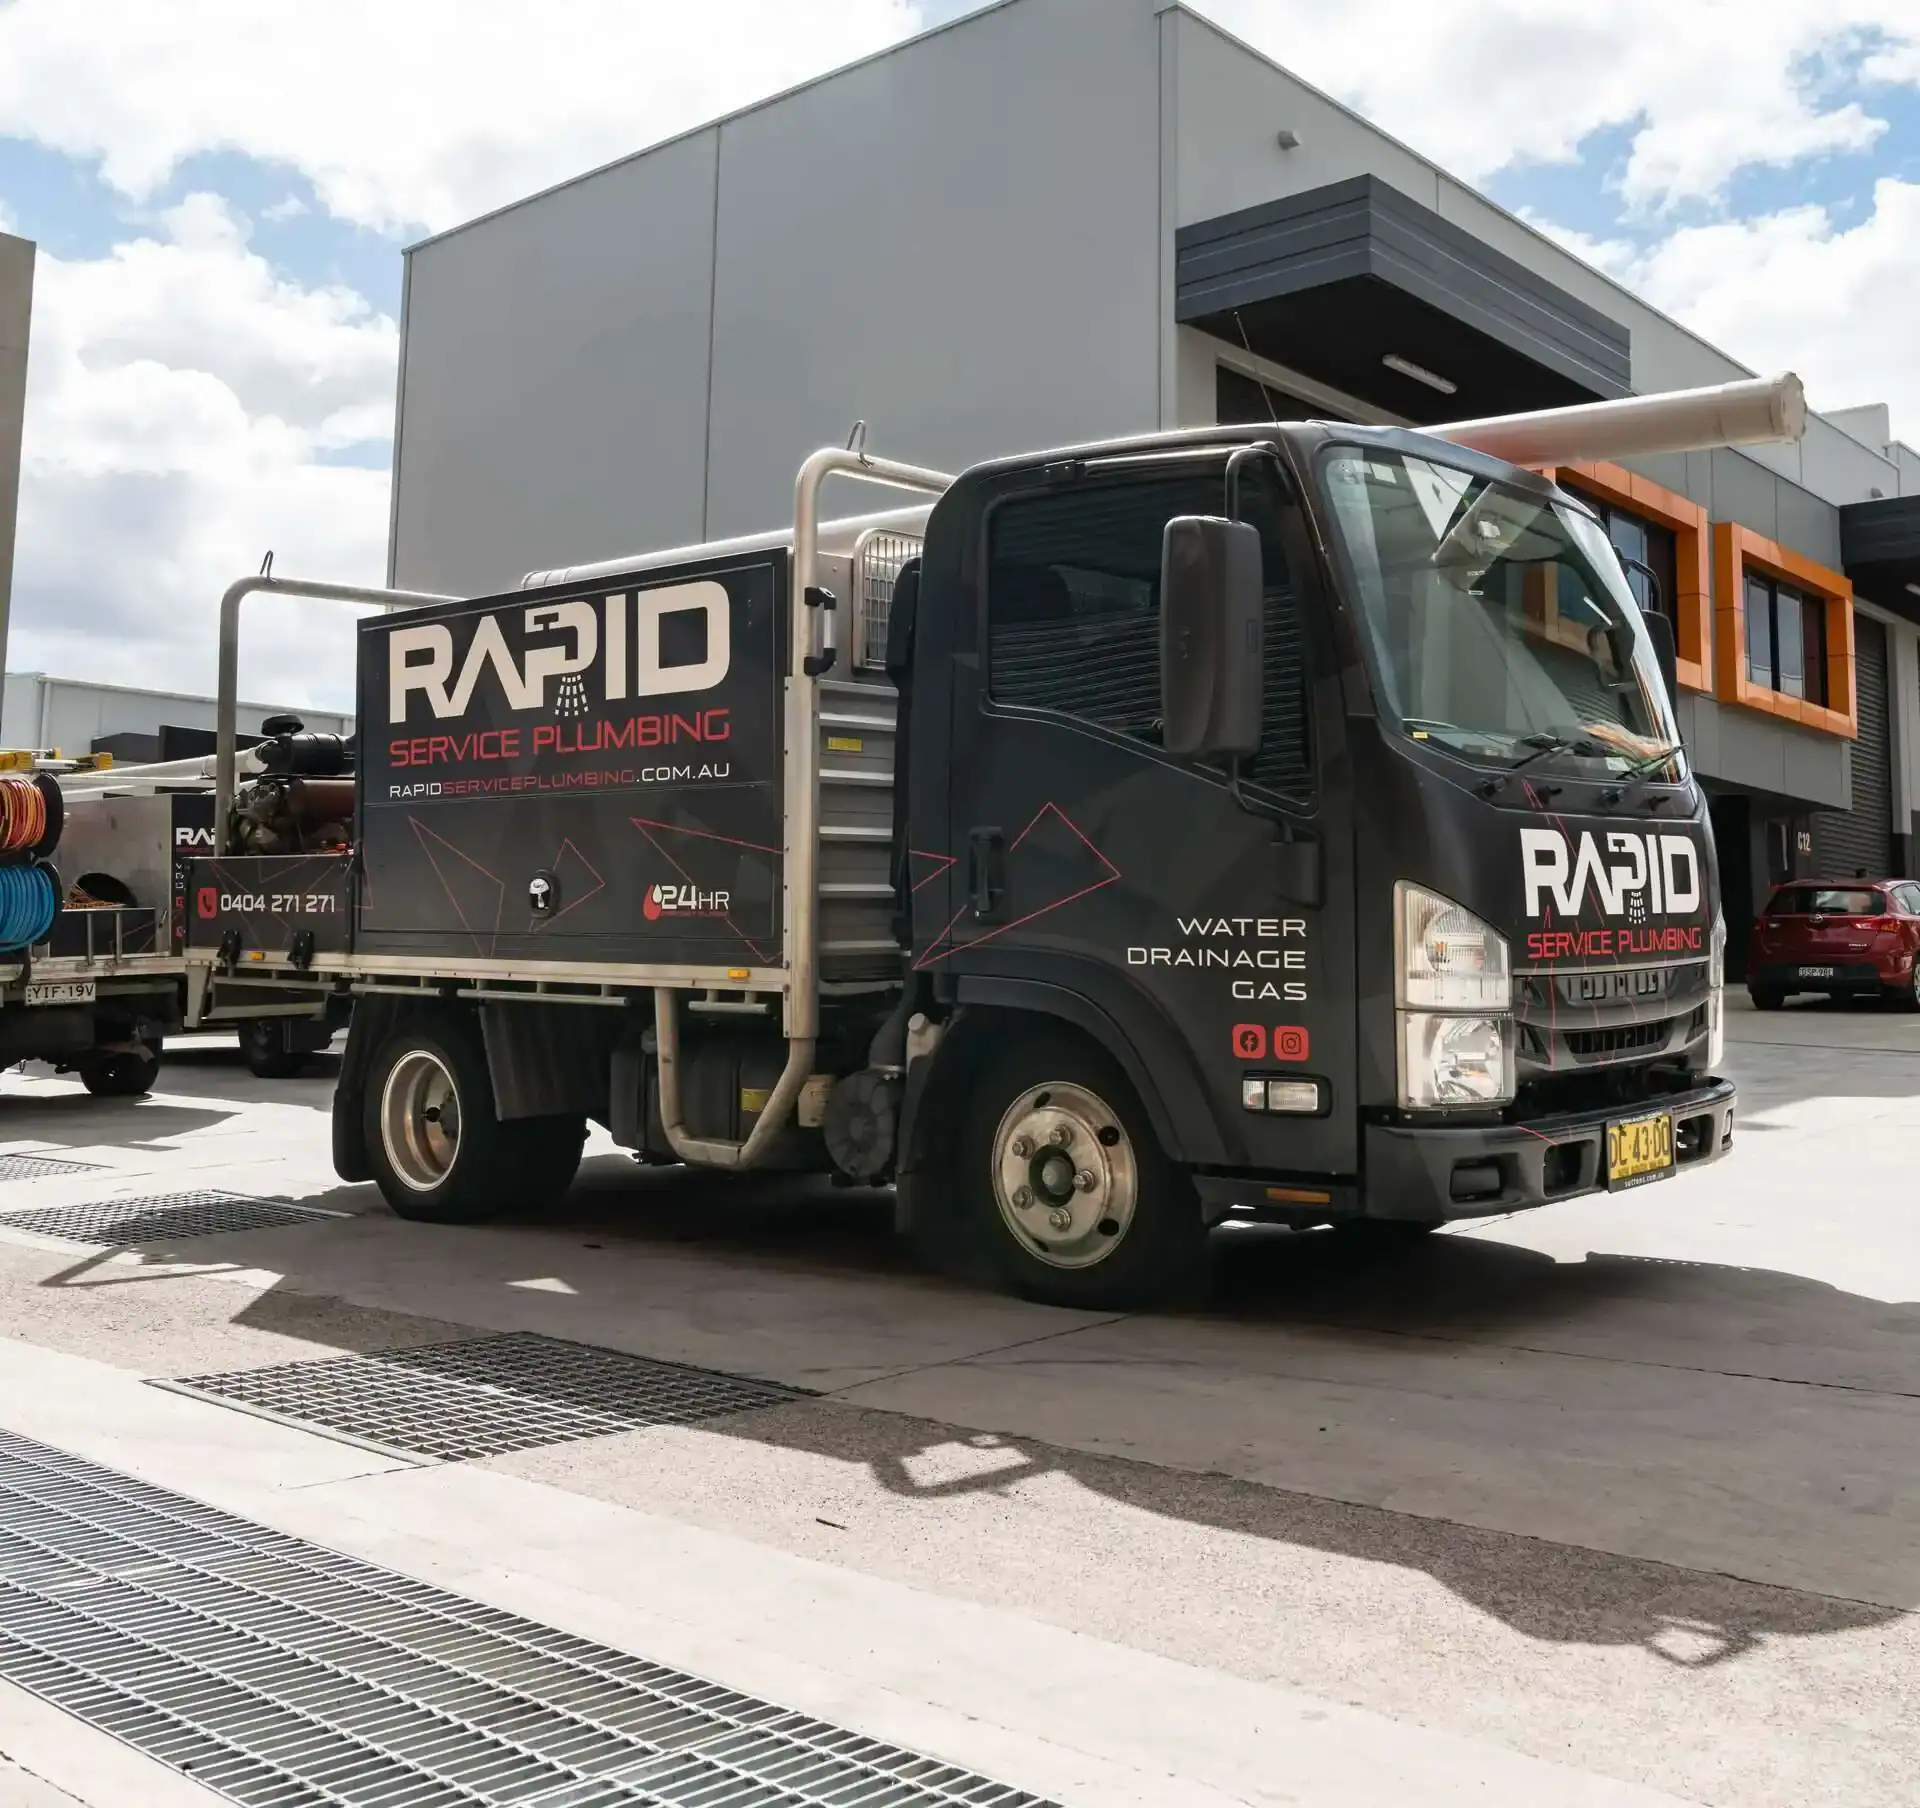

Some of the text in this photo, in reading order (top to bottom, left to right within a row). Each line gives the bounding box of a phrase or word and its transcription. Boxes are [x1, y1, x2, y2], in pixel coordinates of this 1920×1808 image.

[389, 580, 731, 724] RAPID
[389, 708, 731, 767] SERVICE PLUMBING
[389, 762, 731, 798] RAPIDSERVICEPLUMBING.COM.AU
[1519, 828, 1701, 917] RAPID
[220, 893, 336, 913] 0404 271 271
[1177, 917, 1307, 937] WATER
[1527, 927, 1702, 959] SERVICE PLUMBING
[1127, 947, 1306, 969] DRAINAGE
[1232, 981, 1307, 1001] GAS
